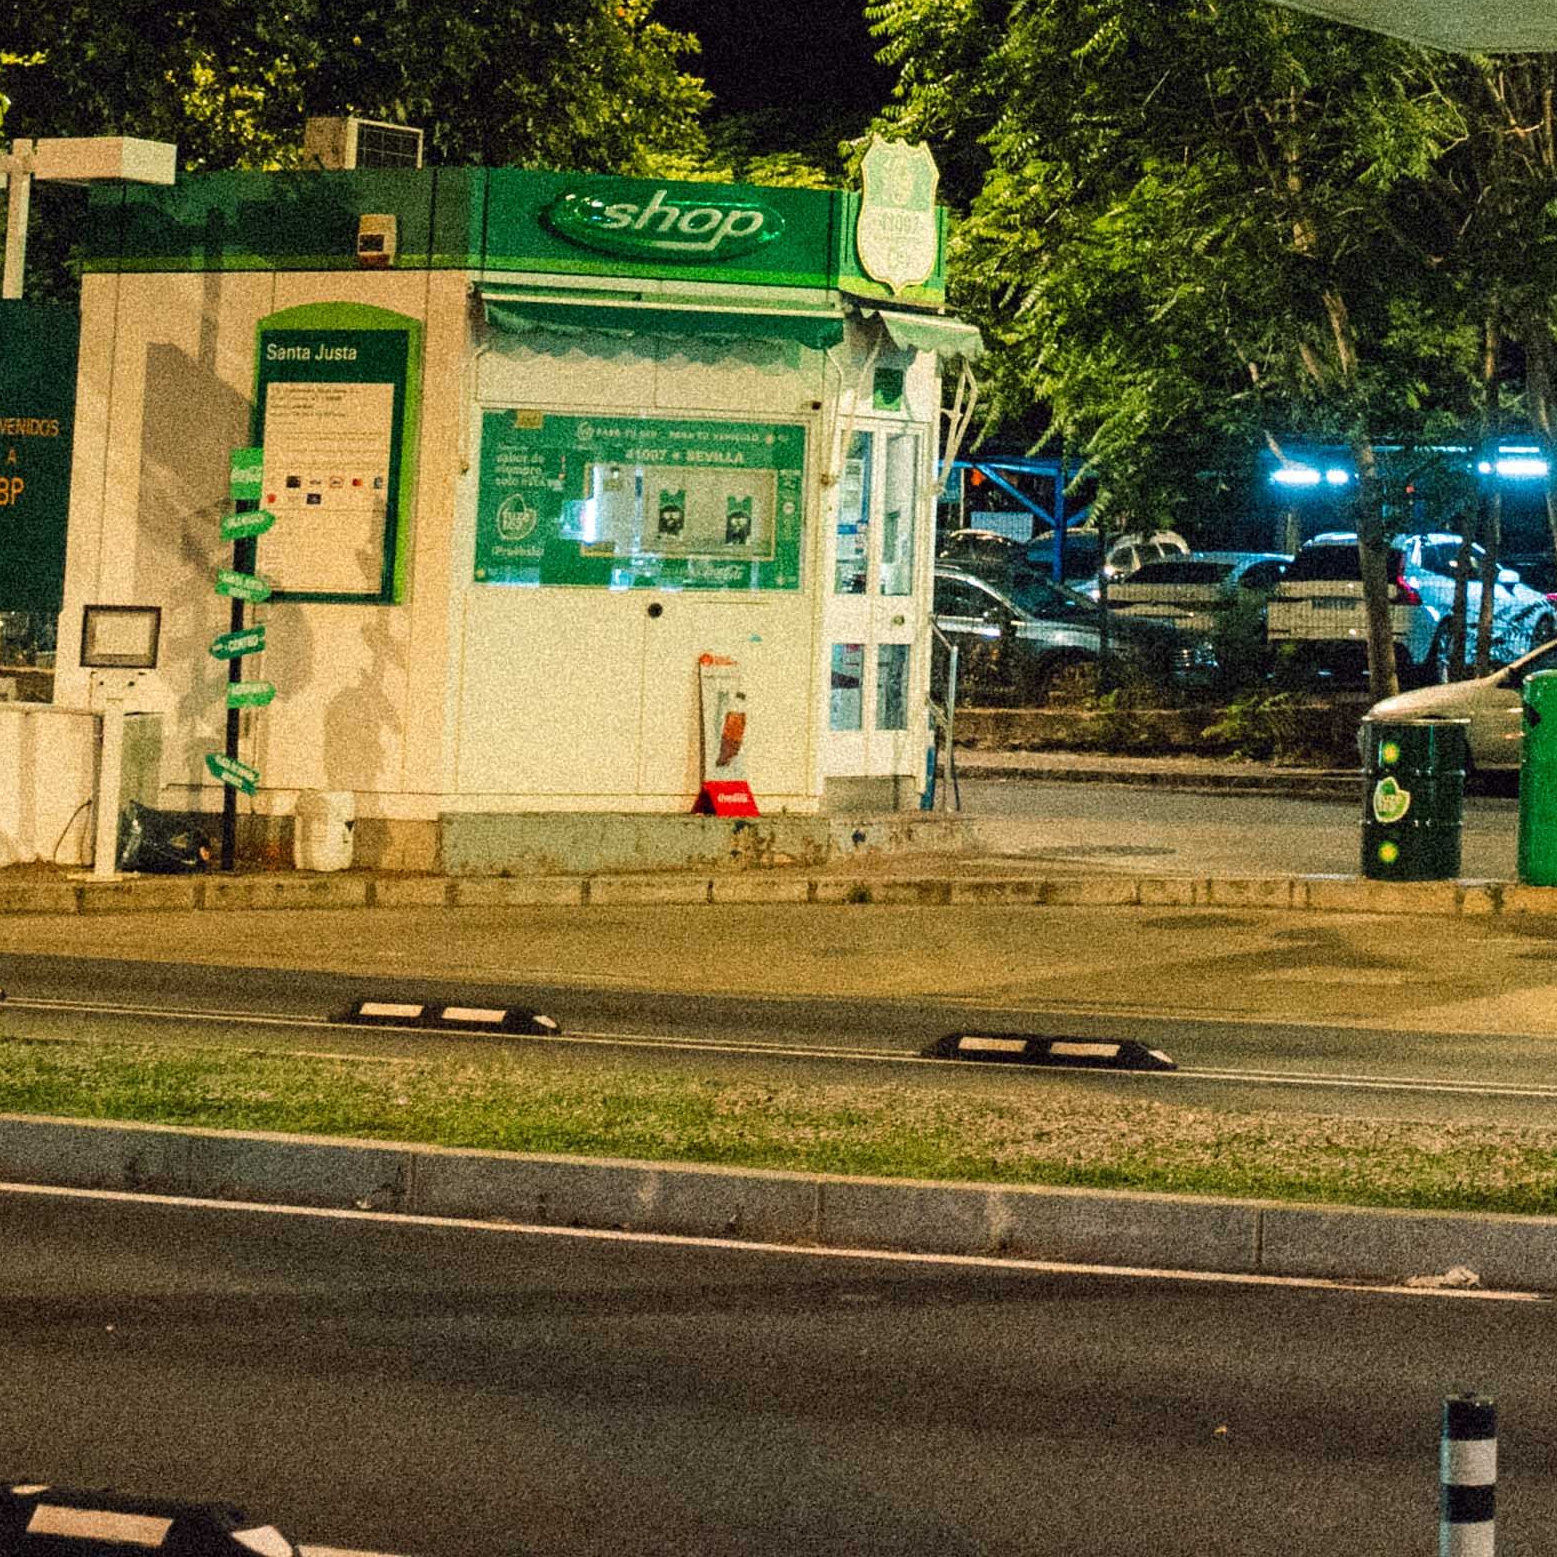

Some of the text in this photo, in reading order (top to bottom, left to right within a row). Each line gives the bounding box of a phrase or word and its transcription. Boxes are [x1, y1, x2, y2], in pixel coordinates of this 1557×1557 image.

[601, 189, 764, 252] shop
[266, 343, 358, 362] Santa Justa
[7, 448, 17, 466] A
[686, 449, 745, 463] SEVILLA
